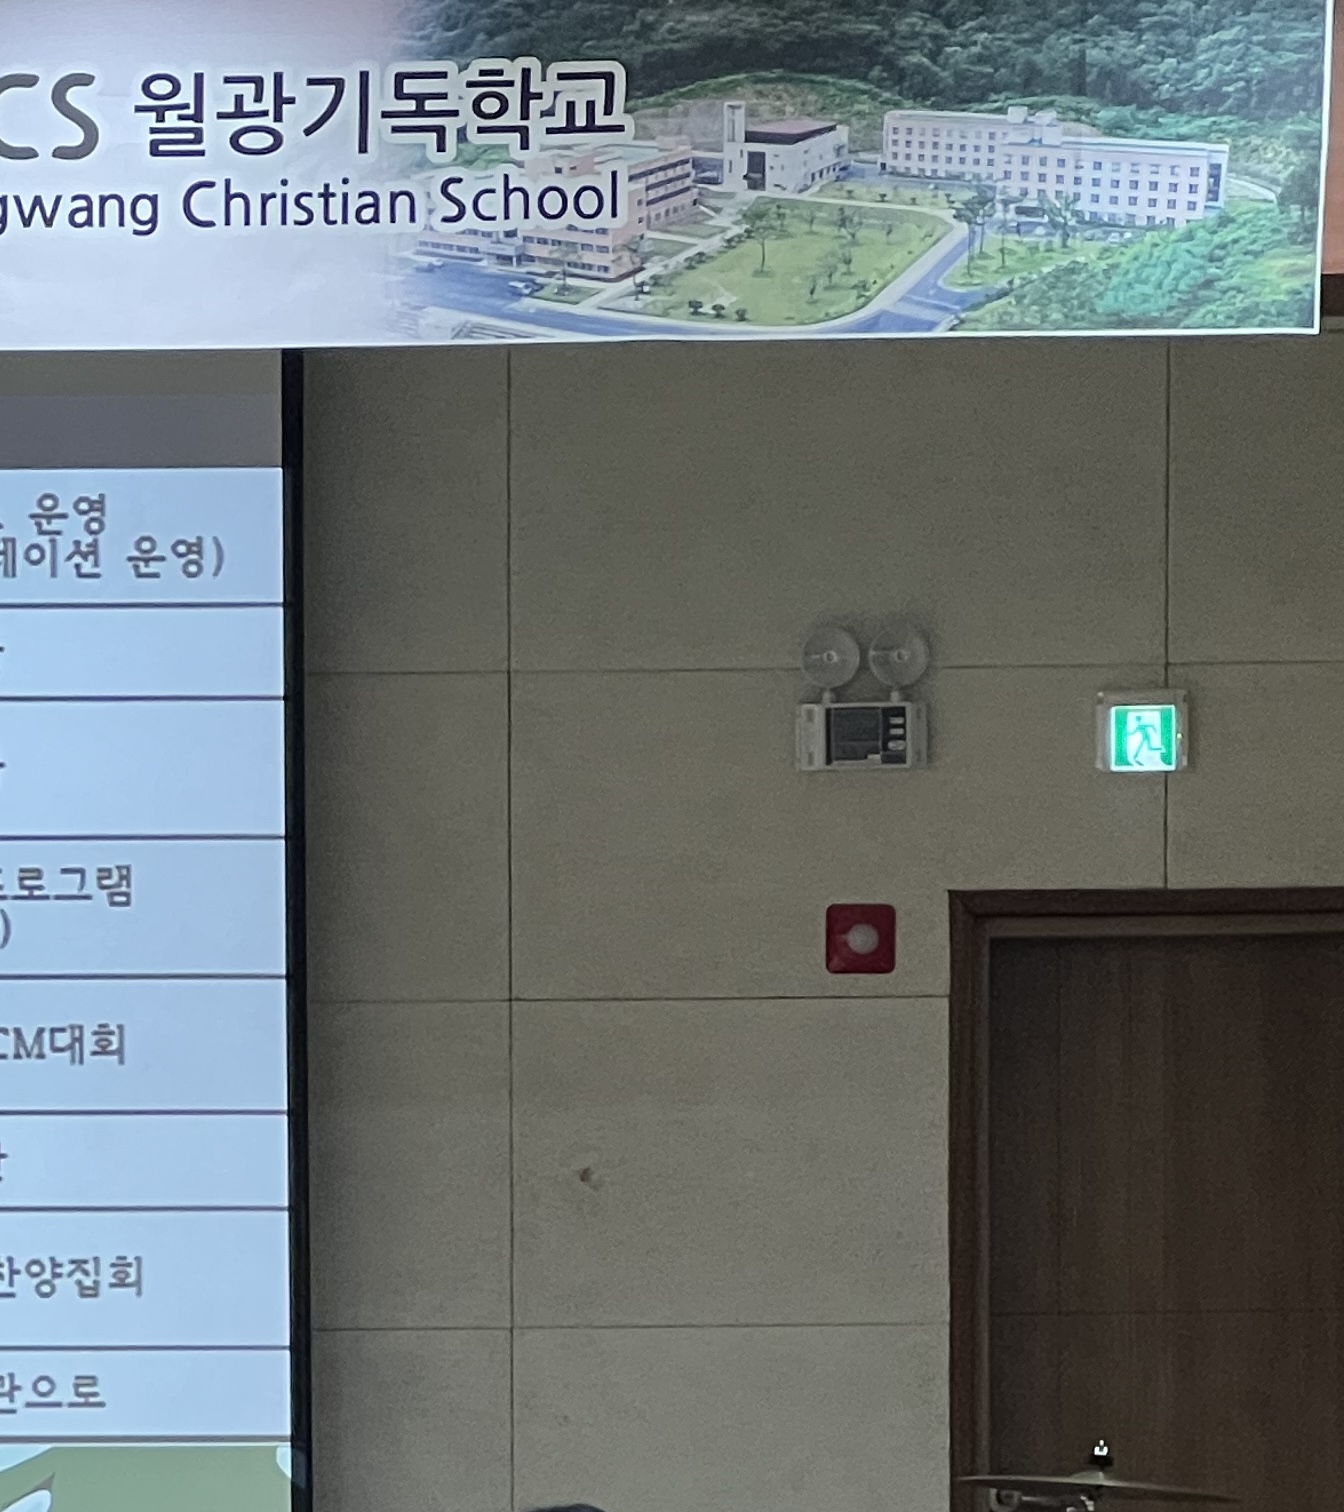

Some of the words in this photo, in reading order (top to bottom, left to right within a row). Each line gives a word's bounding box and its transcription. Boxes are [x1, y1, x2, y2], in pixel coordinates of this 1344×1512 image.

[134, 60, 628, 160] 월광기독학교
[180, 177, 420, 230] Christian
[436, 172, 622, 224] School
[27, 492, 106, 537] 운영
[125, 535, 224, 579] 운영)
